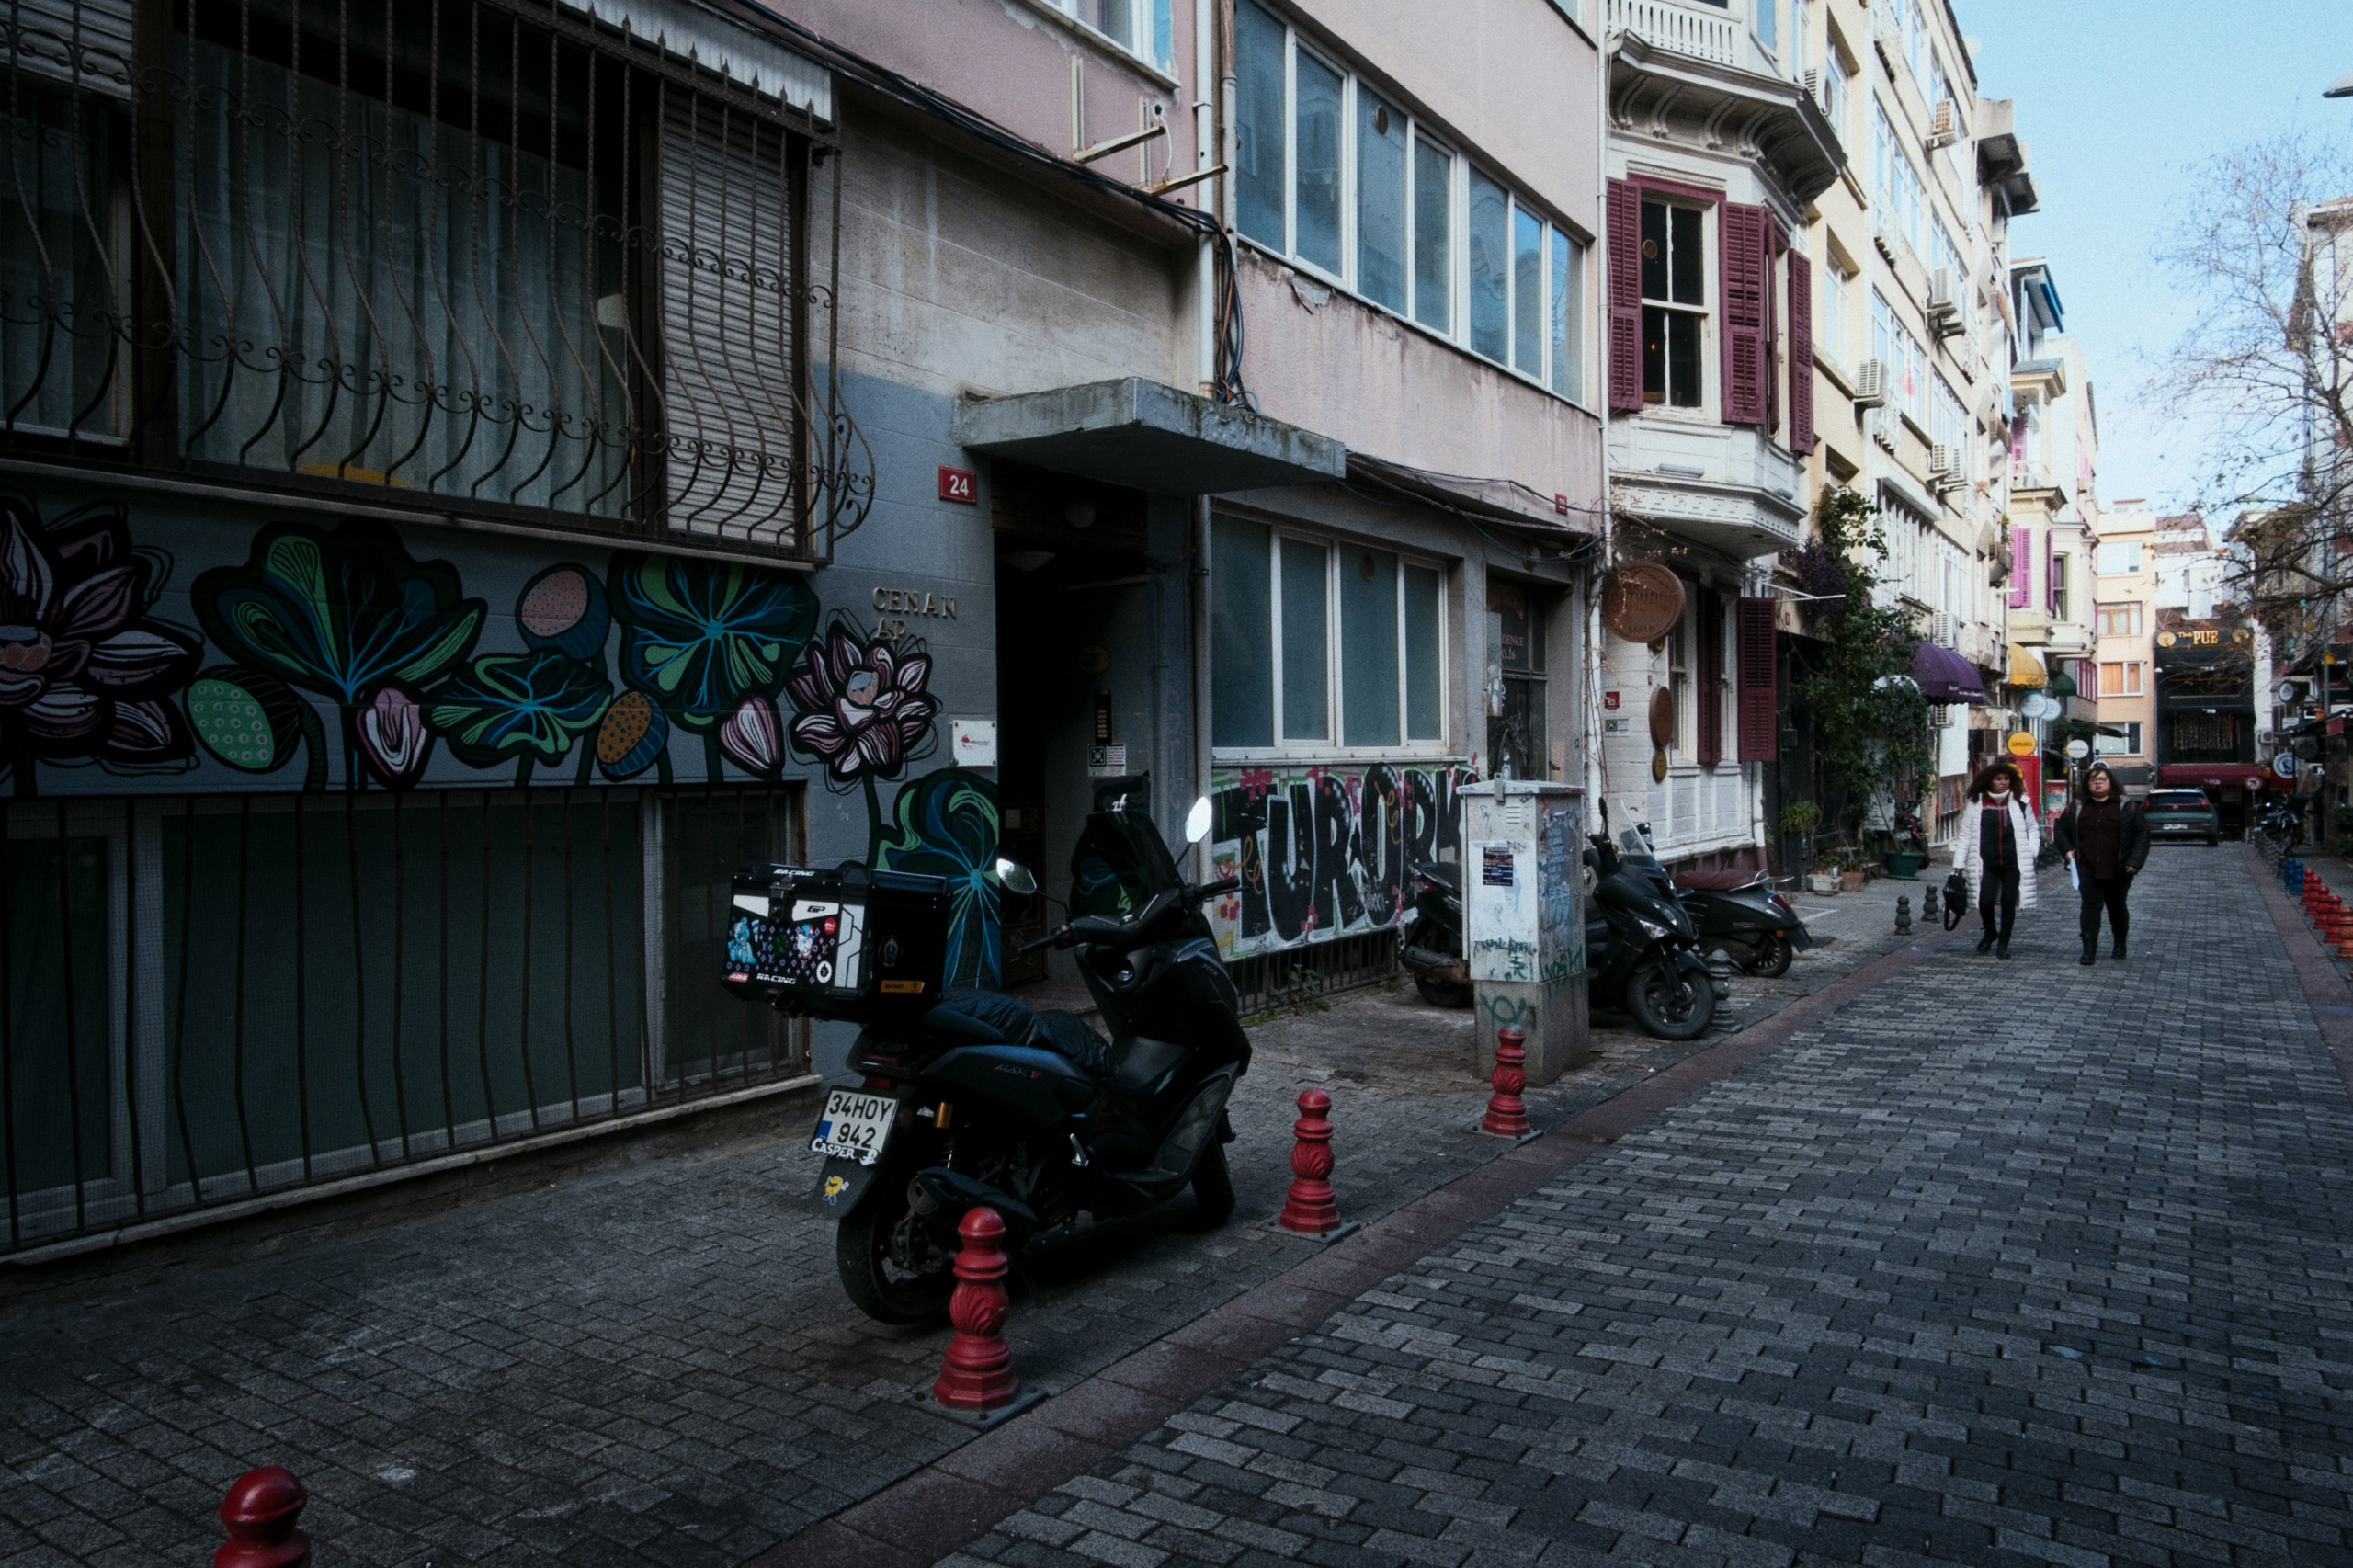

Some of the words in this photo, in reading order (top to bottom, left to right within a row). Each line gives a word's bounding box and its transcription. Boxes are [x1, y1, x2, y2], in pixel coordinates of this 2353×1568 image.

[949, 474, 969, 497] 24
[872, 586, 957, 619] CENAN
[873, 617, 907, 642] AP
[1502, 633, 1524, 647] DENCE
[773, 869, 816, 878] RACING
[807, 904, 826, 914] GP
[756, 972, 797, 985] RACING
[837, 1122, 877, 1149] 942
[811, 1137, 857, 1160] CASPER
